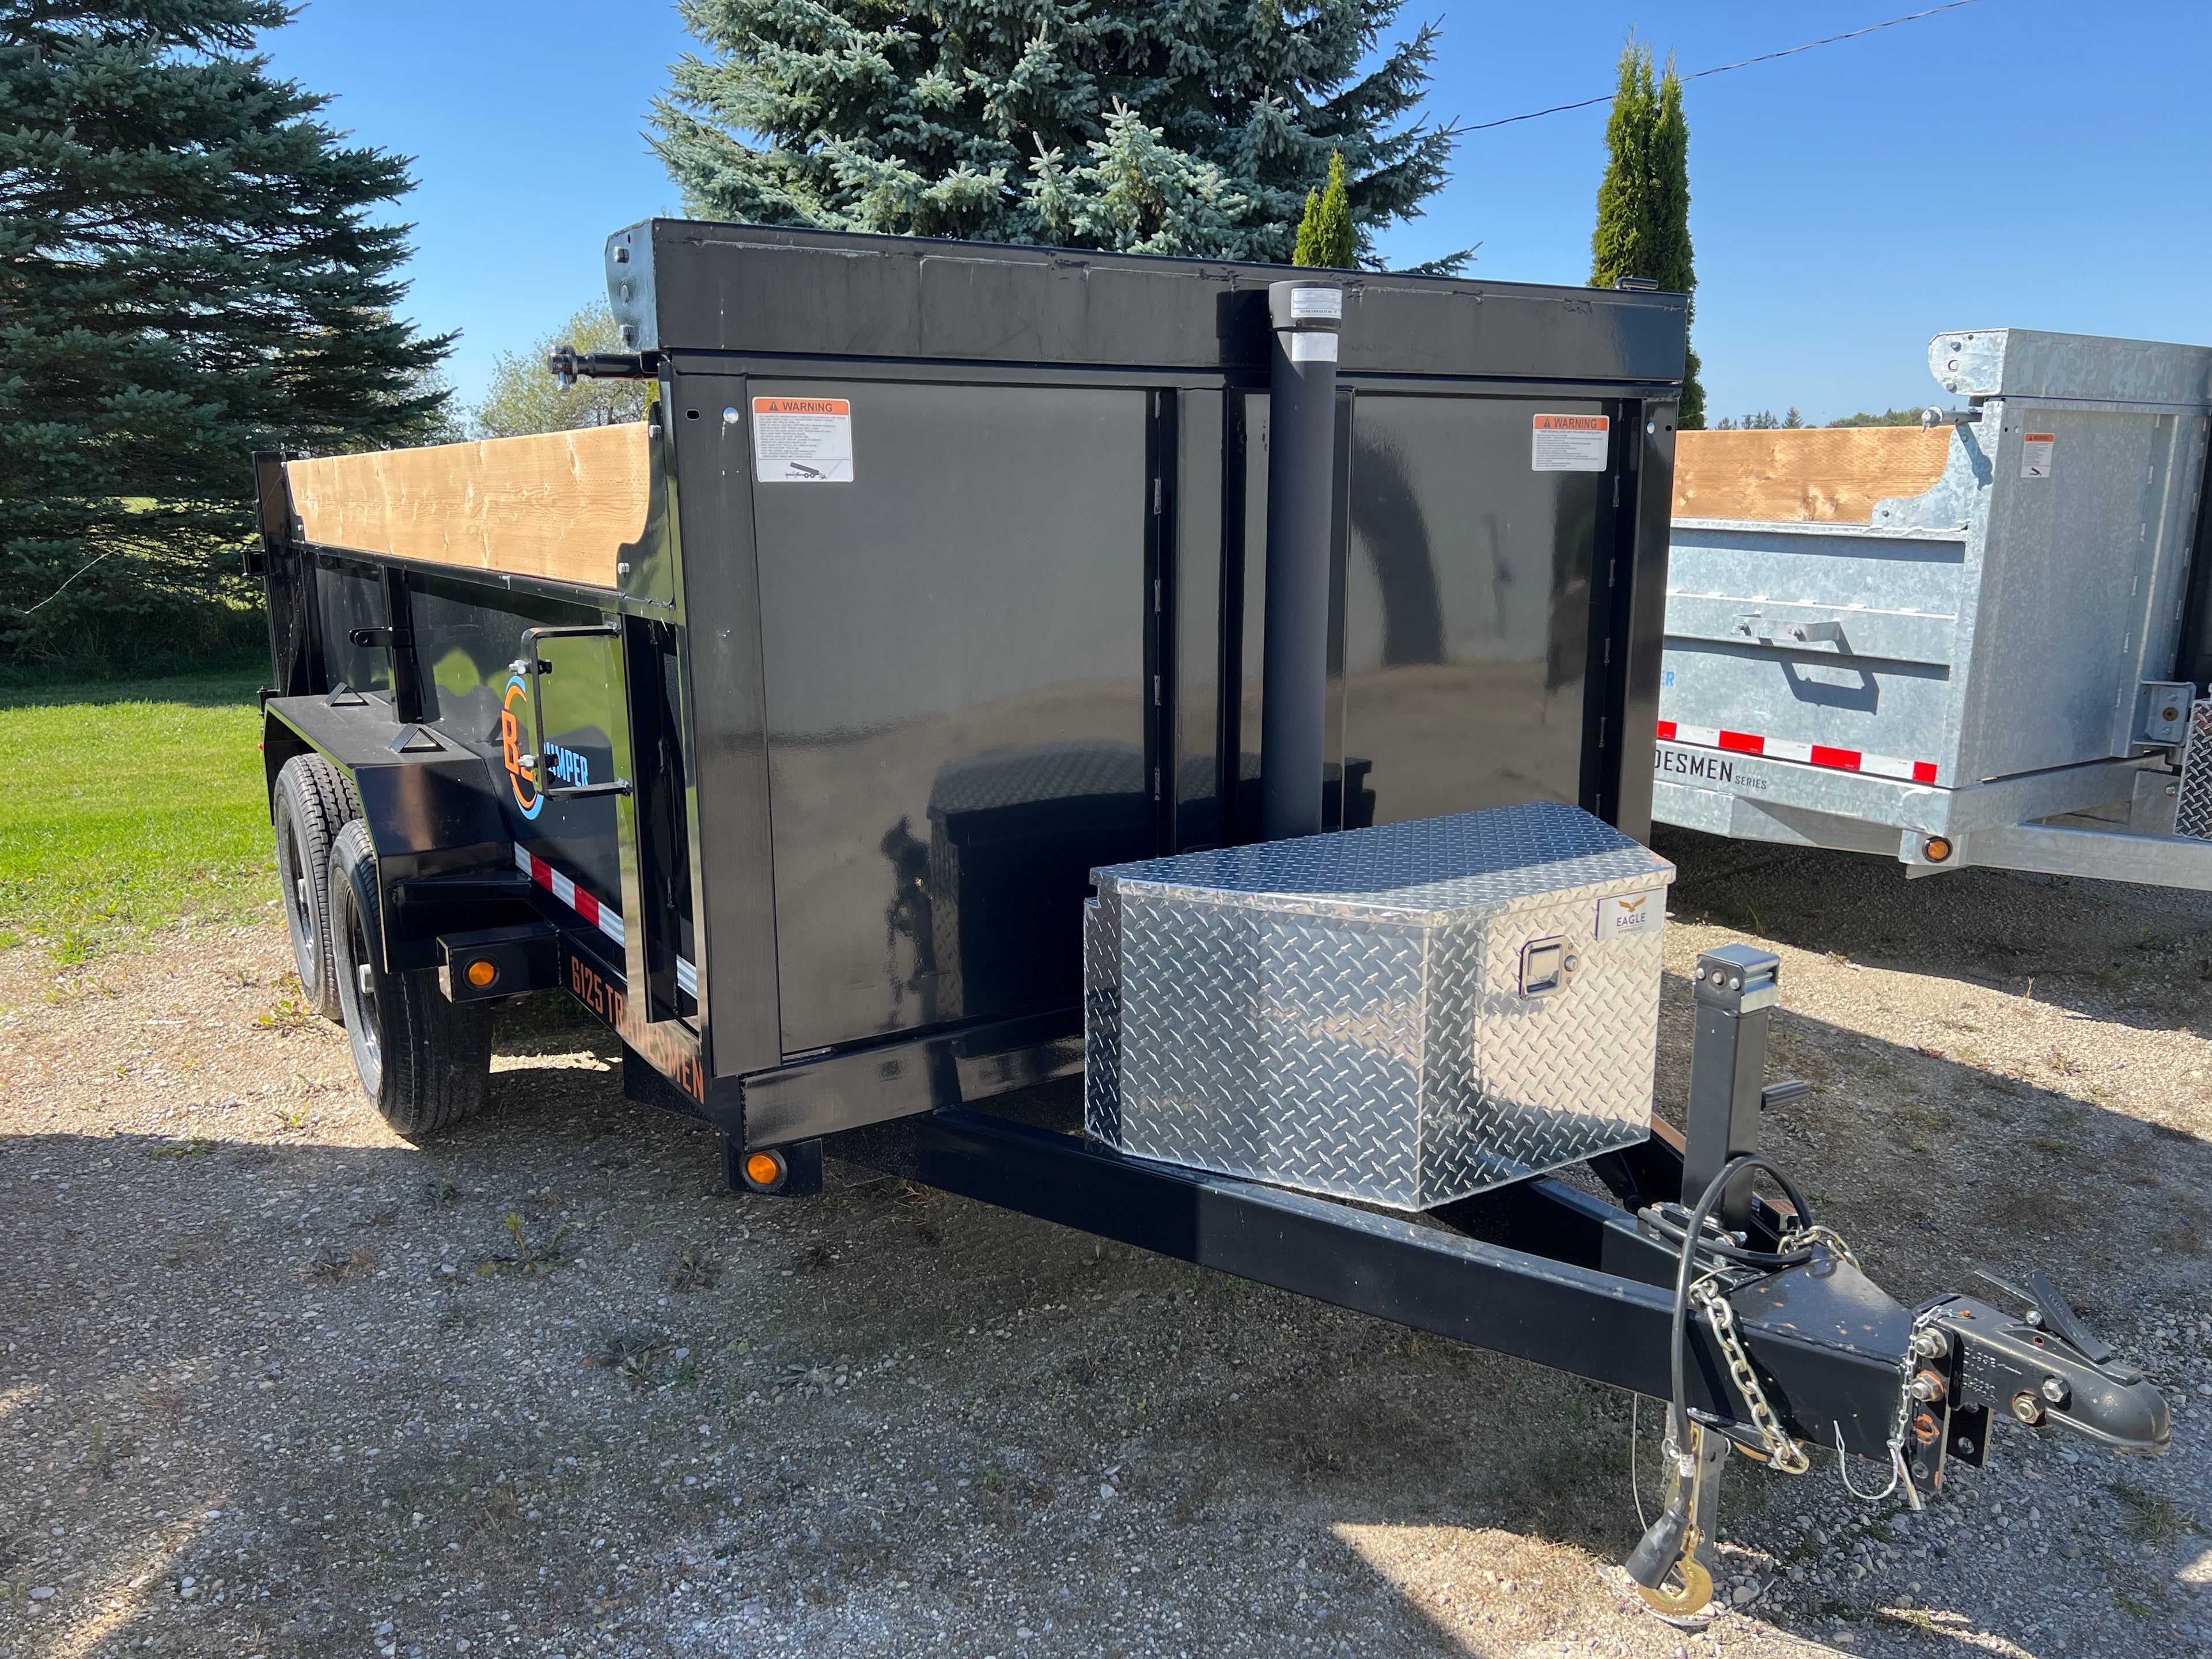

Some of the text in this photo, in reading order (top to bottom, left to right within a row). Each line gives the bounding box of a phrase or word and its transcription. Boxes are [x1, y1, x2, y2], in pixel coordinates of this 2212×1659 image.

[782, 402, 833, 412] WARNING
[1554, 418, 1597, 429] WARNING
[1735, 775, 1767, 789] SERIES
[1616, 912, 1646, 927] EAGLE
[571, 955, 705, 1105] 6125 TRADESMEN
